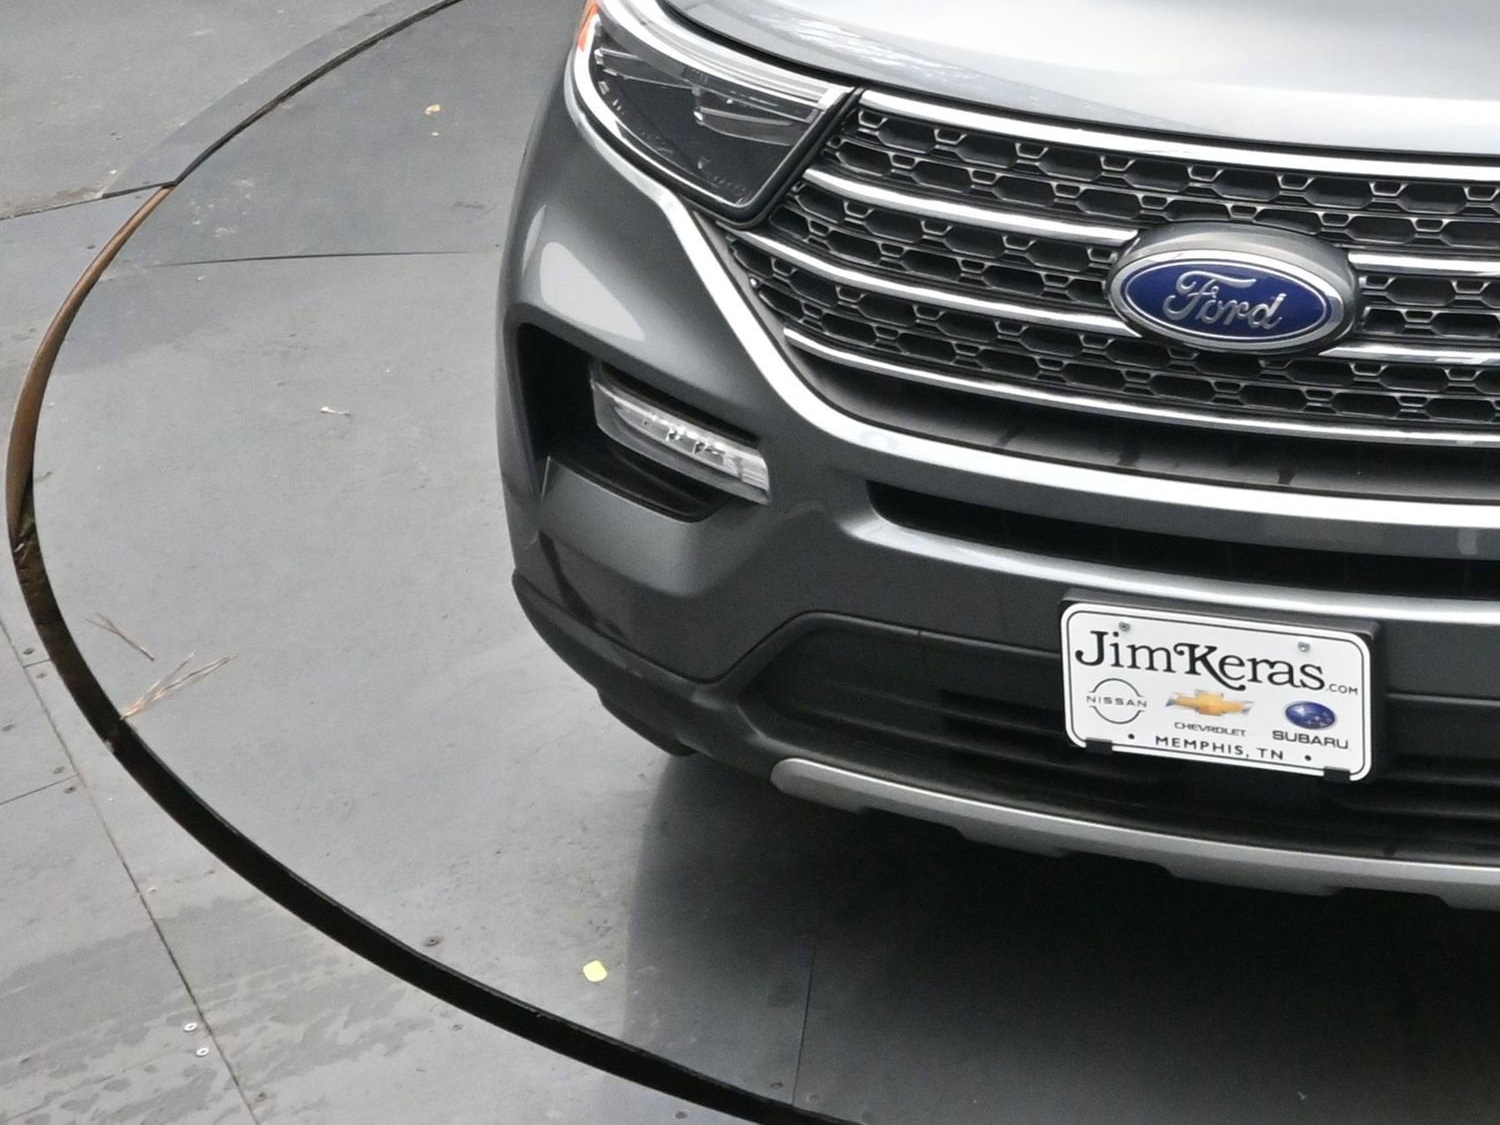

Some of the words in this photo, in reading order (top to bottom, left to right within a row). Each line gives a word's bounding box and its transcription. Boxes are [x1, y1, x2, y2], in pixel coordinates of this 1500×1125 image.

[1162, 269, 1287, 330] Ford
[1086, 695, 1147, 708] NISSAN
[1174, 721, 1247, 737] CHEVROLET
[1155, 735, 1249, 758] MEMPHIS,
[1256, 747, 1284, 760] TN
[1272, 730, 1349, 750] SUBARU
